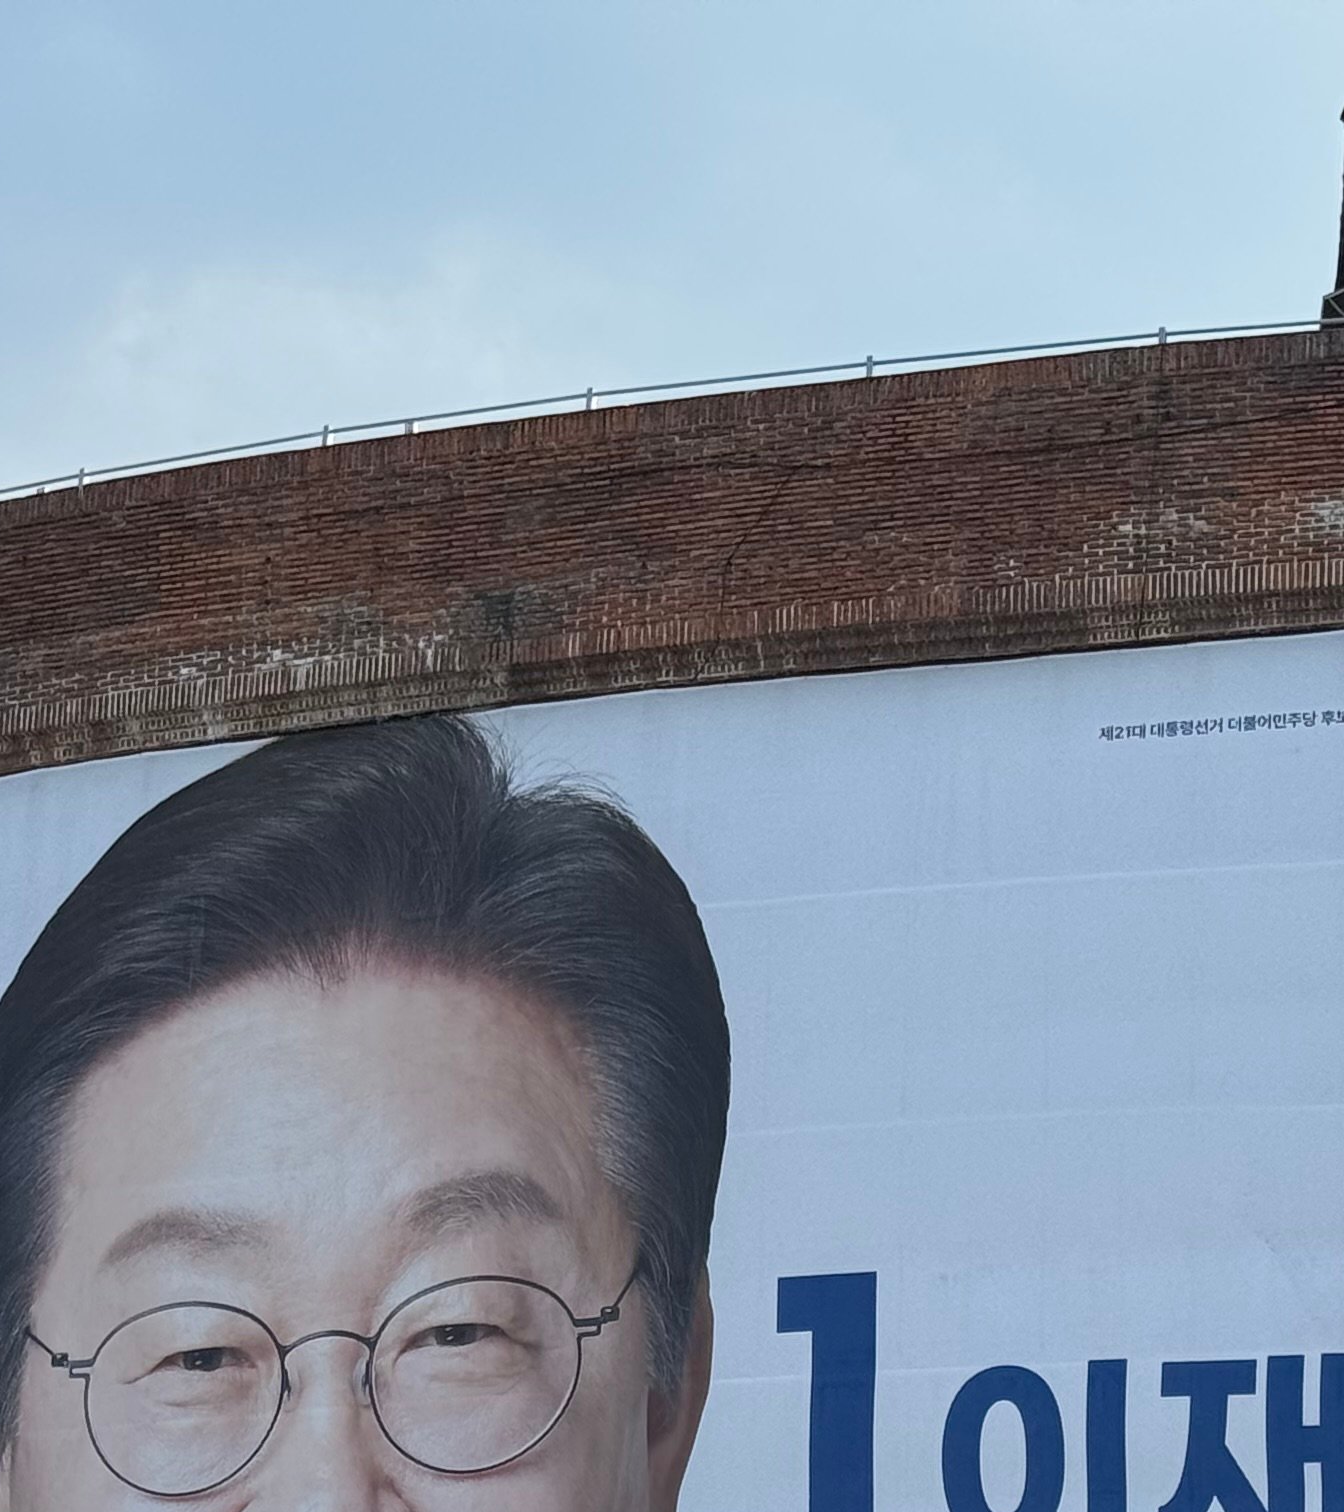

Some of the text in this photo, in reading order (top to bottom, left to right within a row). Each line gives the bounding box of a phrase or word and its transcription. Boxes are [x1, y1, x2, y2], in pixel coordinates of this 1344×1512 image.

[1098, 724, 1147, 742] 제21대
[1150, 716, 1224, 739] 대통령선거
[1227, 709, 1318, 733] 더불어민주당
